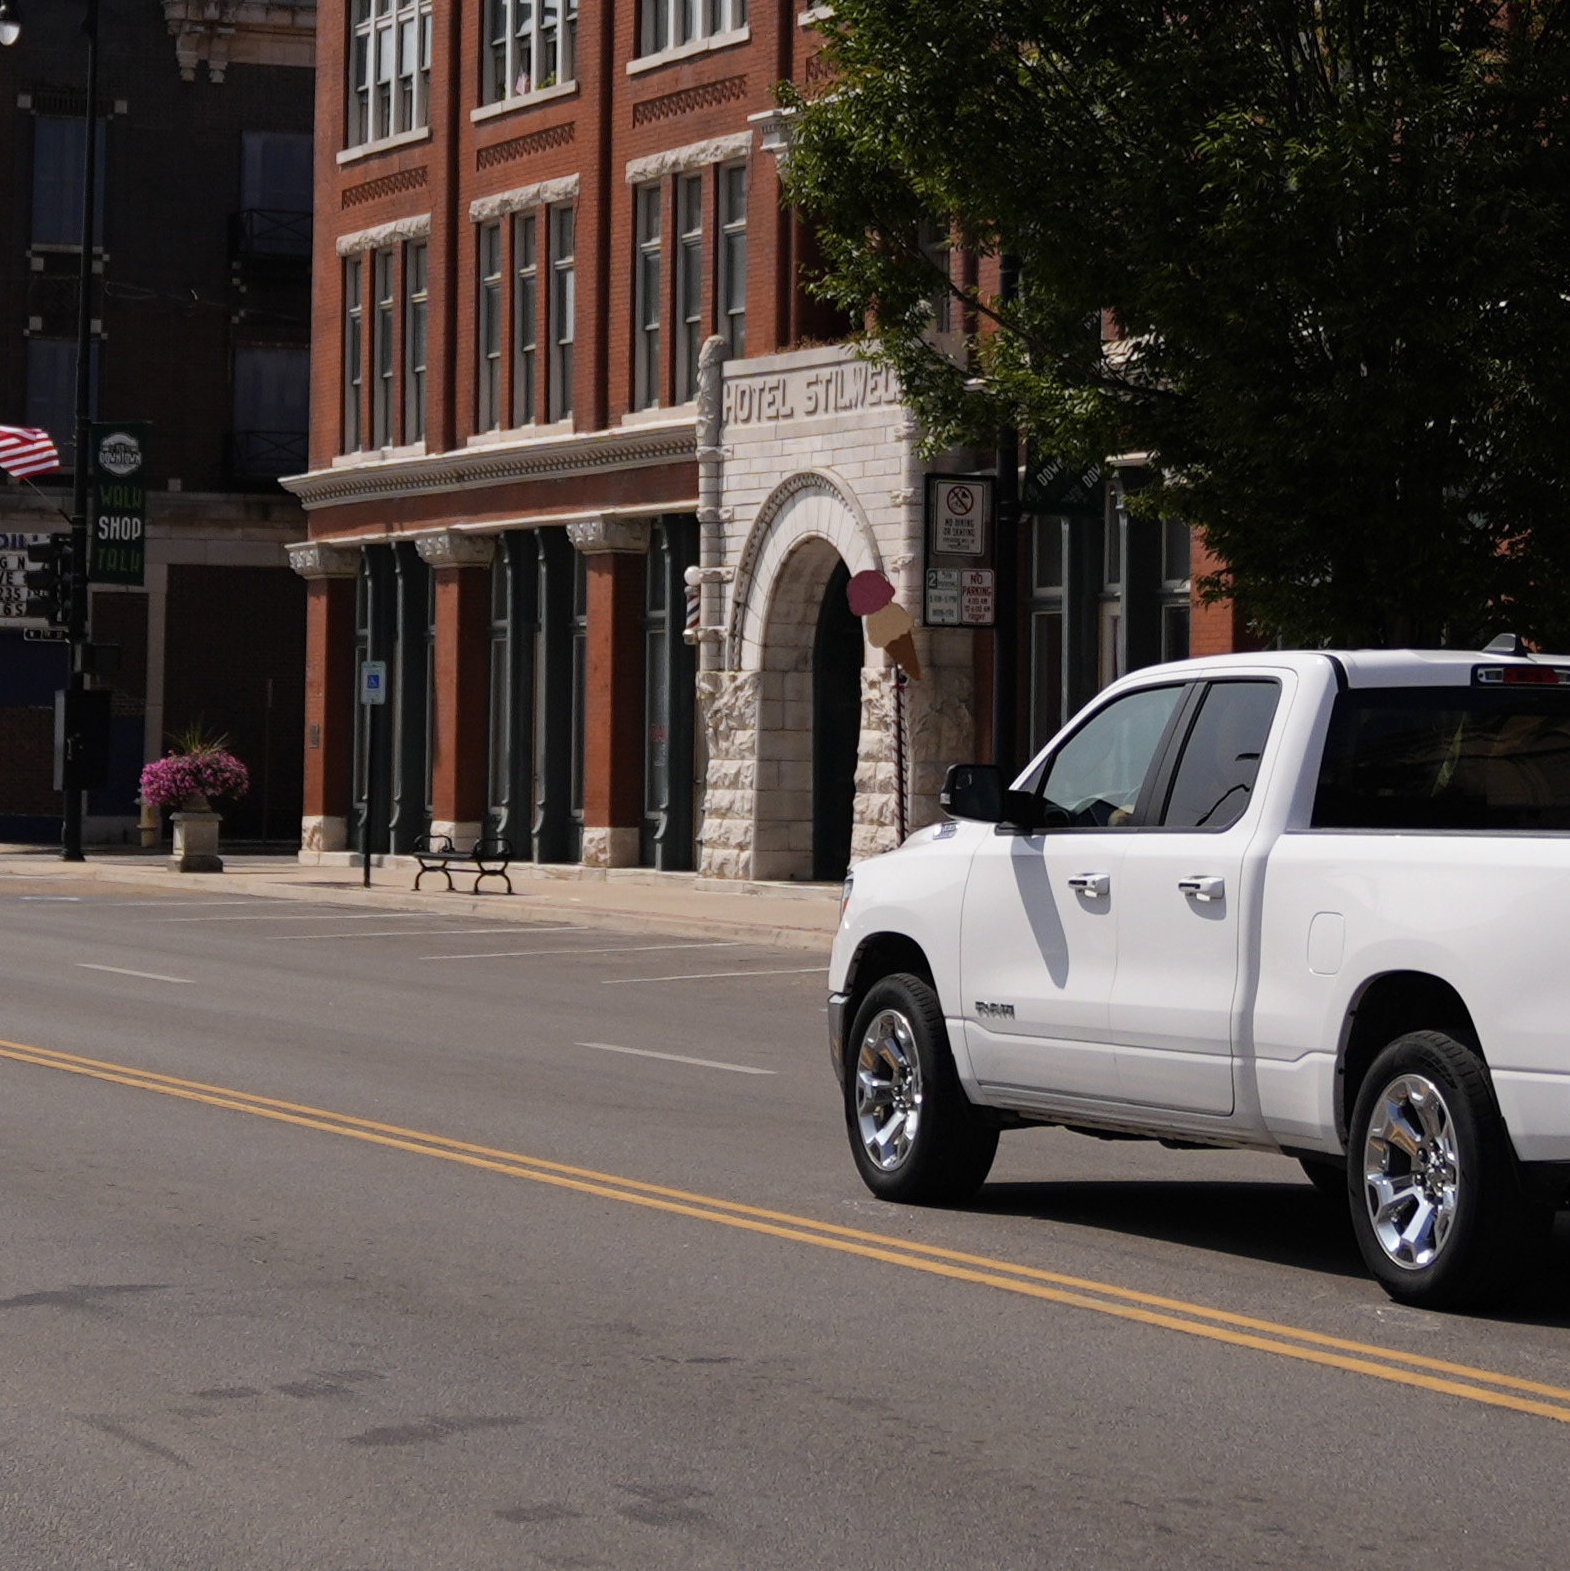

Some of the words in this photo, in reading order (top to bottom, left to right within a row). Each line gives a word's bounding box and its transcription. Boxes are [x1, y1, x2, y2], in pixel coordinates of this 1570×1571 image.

[723, 378, 794, 425] HOTEL
[804, 361, 903, 417] STILWEL
[99, 485, 143, 509] WALK
[98, 515, 142, 541] SHOP
[97, 548, 140, 572] TALK
[928, 572, 937, 587] 2
[962, 585, 991, 597] PARKING
[970, 574, 983, 585] NO
